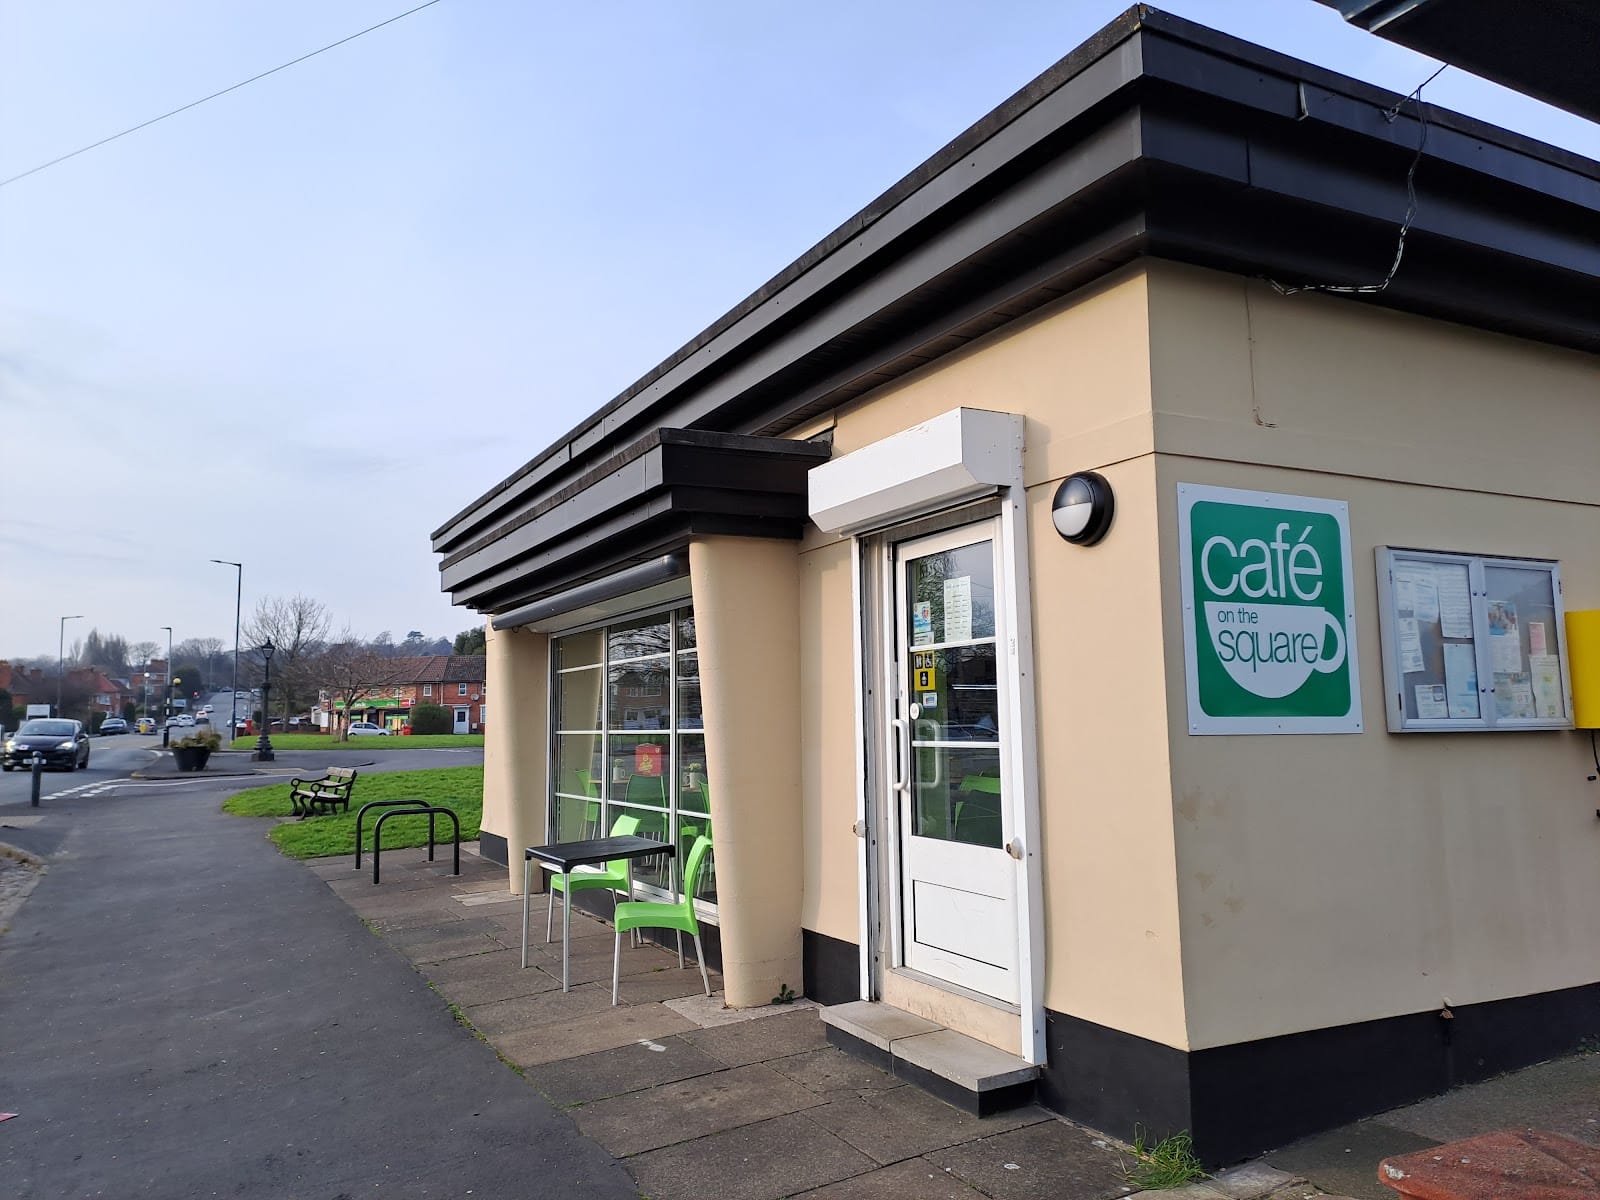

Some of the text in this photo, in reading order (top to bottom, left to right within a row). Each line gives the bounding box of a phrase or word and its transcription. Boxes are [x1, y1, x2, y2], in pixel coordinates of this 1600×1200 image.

[1201, 523, 1323, 601] café
[1217, 608, 1259, 624] on the
[1218, 630, 1319, 673] square
